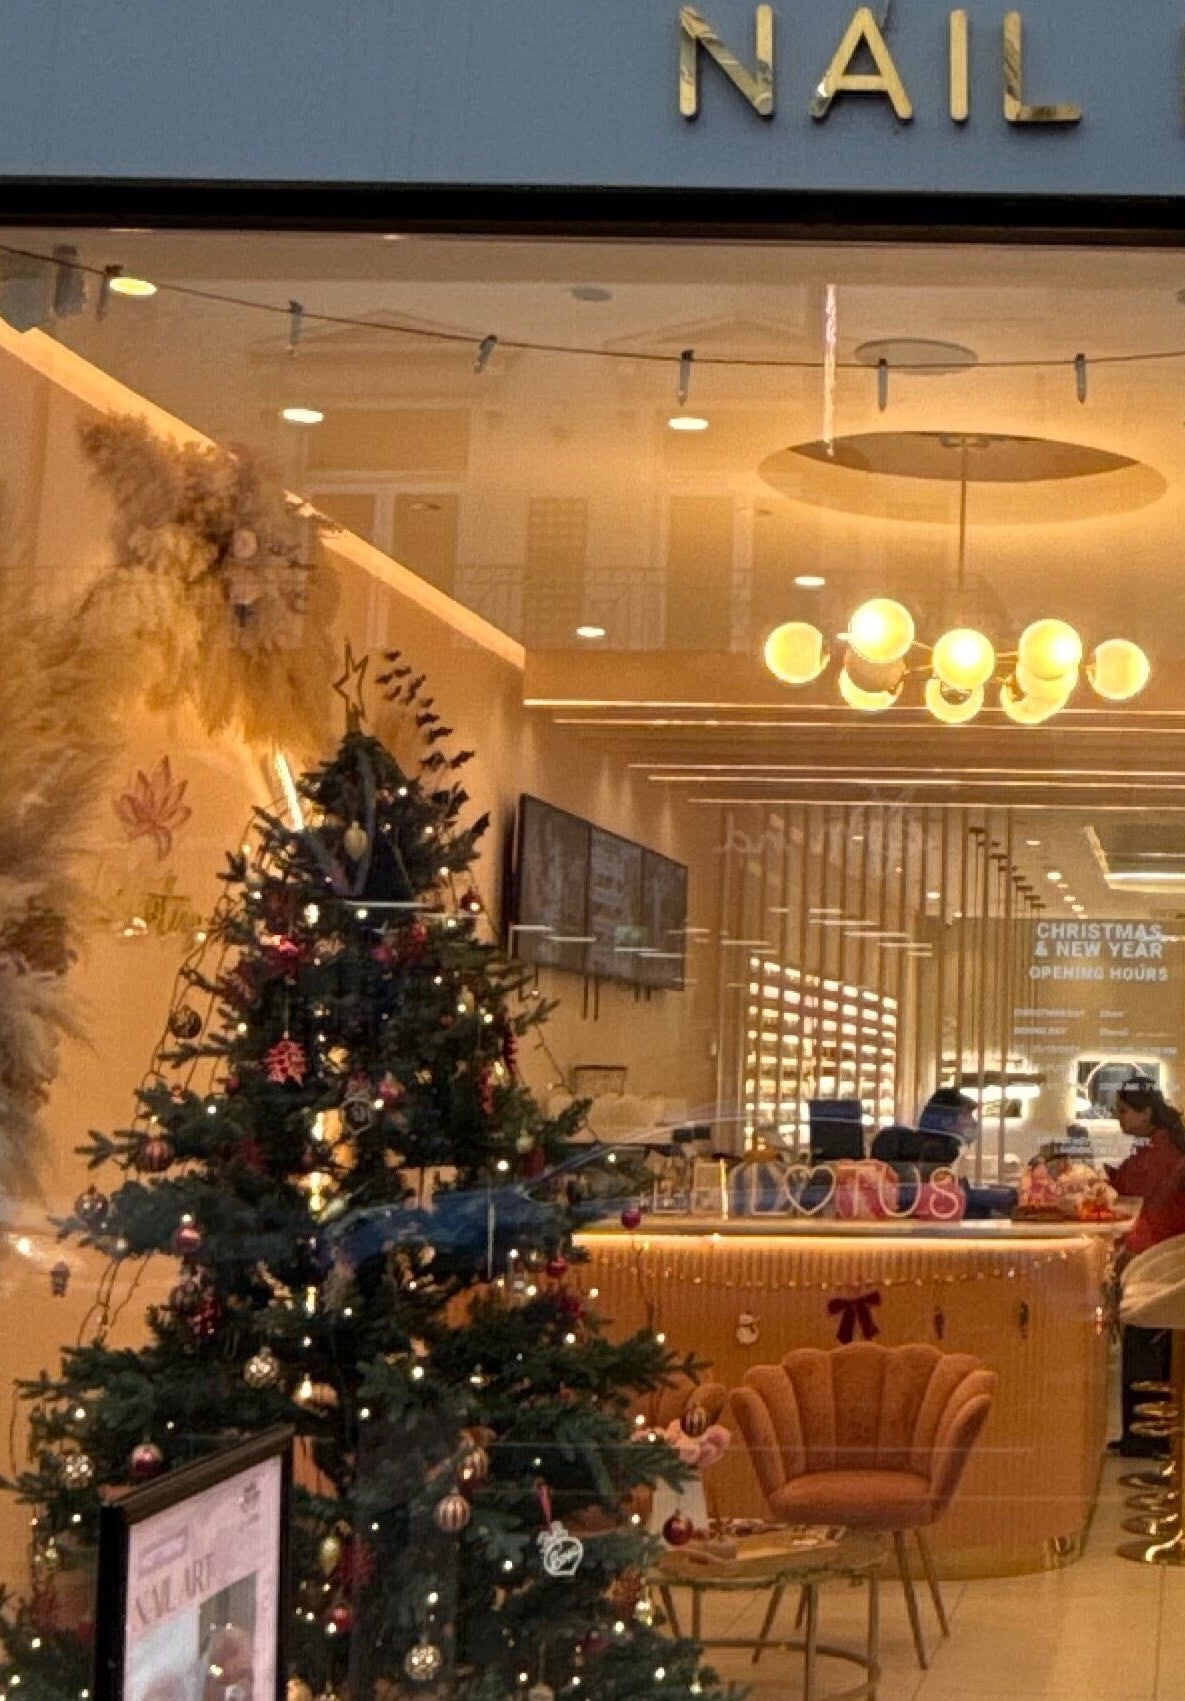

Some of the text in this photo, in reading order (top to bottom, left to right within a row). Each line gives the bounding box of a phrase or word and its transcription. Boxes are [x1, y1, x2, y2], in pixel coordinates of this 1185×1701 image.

[678, 4, 1082, 122] NAIL
[1036, 922, 1164, 941] CHRISTMAS
[1056, 941, 1102, 958] NEW
[1109, 942, 1164, 959] YEAR
[1029, 965, 1105, 980] OPENING
